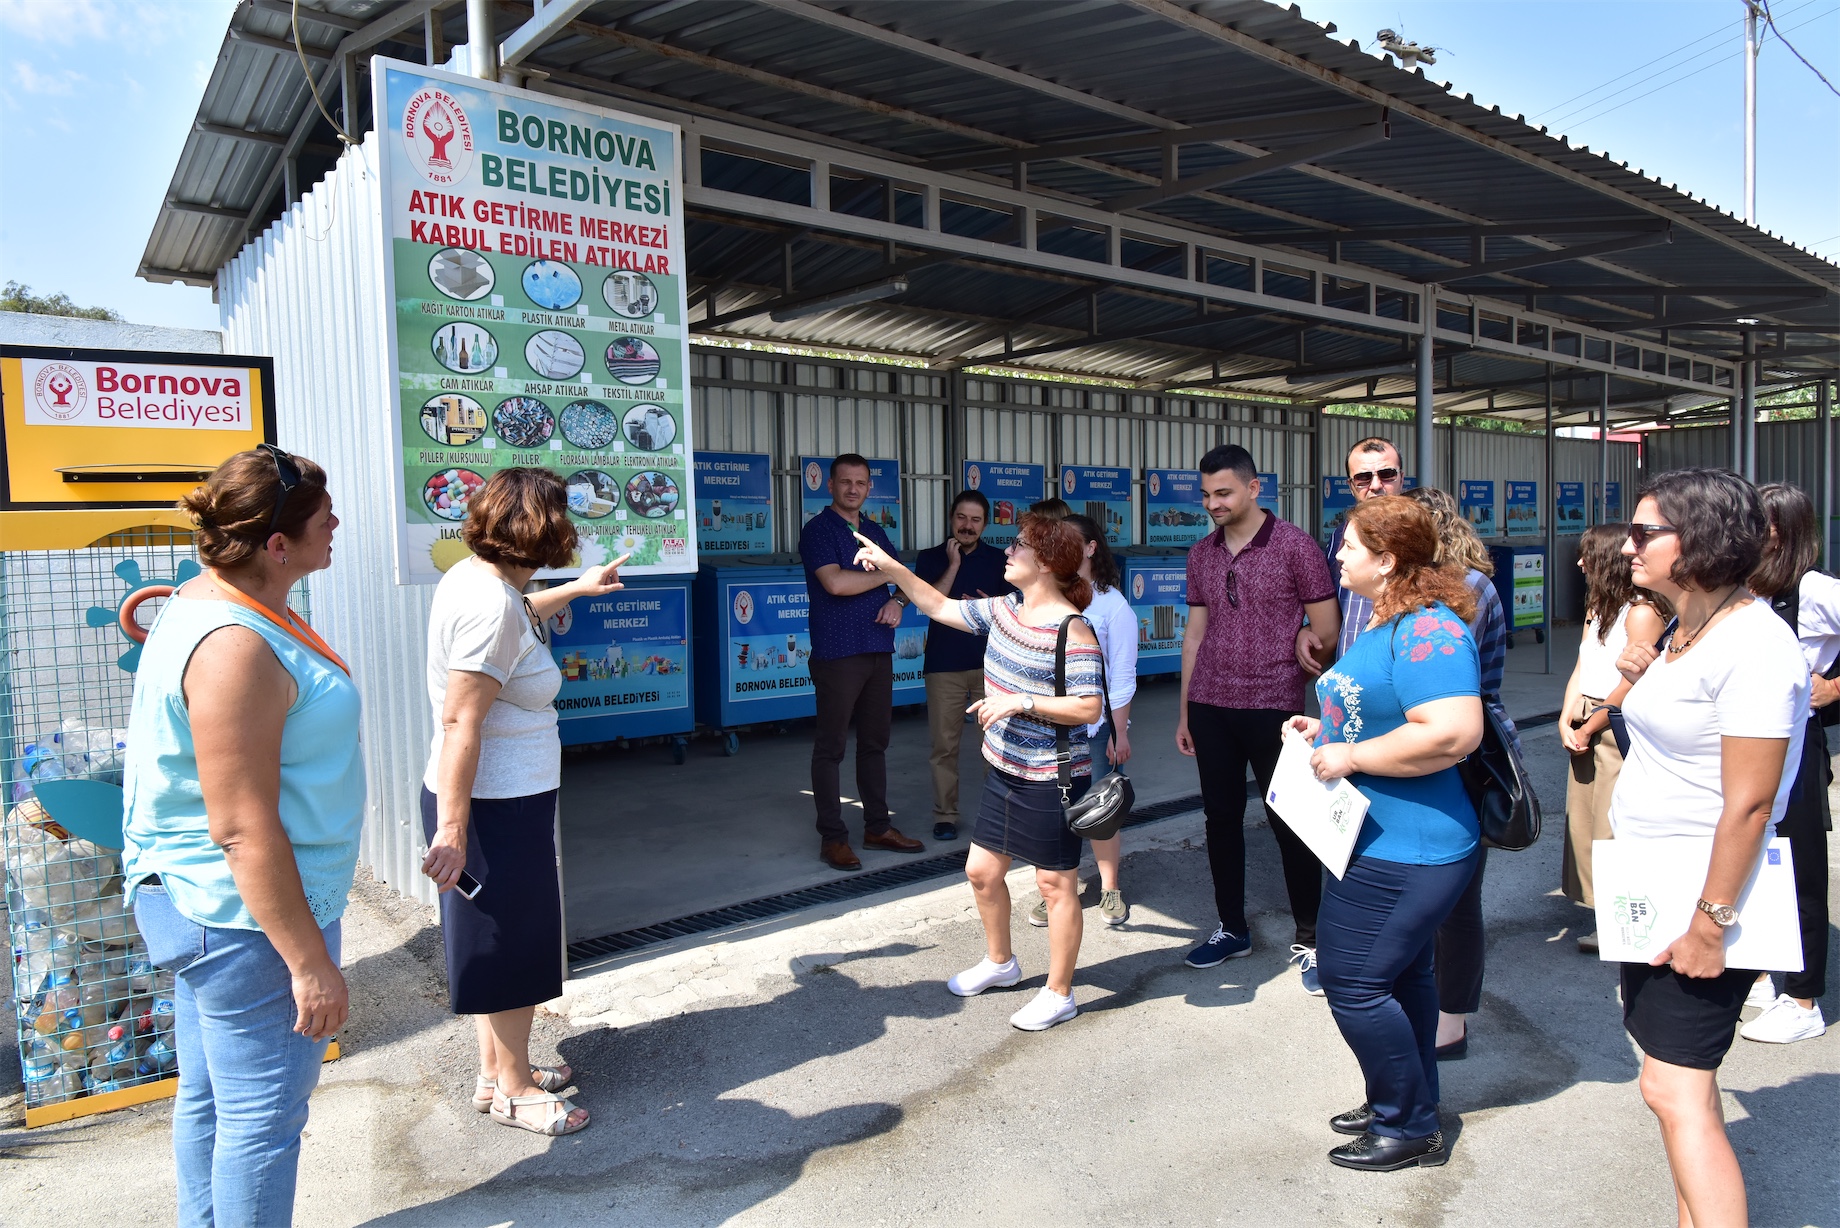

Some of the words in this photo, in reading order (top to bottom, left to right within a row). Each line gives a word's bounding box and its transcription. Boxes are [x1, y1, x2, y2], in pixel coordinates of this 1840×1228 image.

[406, 92, 431, 138] BORNOVA
[435, 91, 474, 152] BELEDİYESİ
[497, 109, 656, 172] BORNOVA
[428, 172, 452, 183] 1881
[481, 153, 671, 217] BELEDİYESİ
[408, 190, 466, 220] ATIK
[473, 201, 572, 235] GETİRME
[580, 216, 669, 249] MERKEZİ
[410, 220, 492, 253] KABUL
[499, 231, 578, 264] EDİLEN
[585, 245, 670, 276] ATIKLAR
[421, 300, 444, 315] KAĞIT
[446, 304, 475, 318] KARTON
[477, 308, 505, 320] ATIKLAR
[522, 311, 553, 326] PLASTİK
[555, 316, 586, 329] ATIKLAR
[608, 320, 629, 333] METAL
[630, 323, 655, 335] ATIKLAR
[96, 366, 241, 397] Bornova
[440, 377, 459, 390] CAM
[461, 379, 494, 392] ATIKLAR
[524, 382, 552, 397] AHŞAP
[555, 384, 588, 397] ATIKLAR
[602, 386, 632, 400] TEKSTİL
[634, 389, 665, 401] ATIKLAR
[97, 396, 241, 427] Belediyesi
[420, 448, 445, 463] PİLLER
[512, 450, 540, 465] PİLLER
[560, 454, 589, 465] FLORASAN
[591, 455, 620, 466] LAMBALAR
[656, 457, 678, 467] ATIKLAR
[693, 461, 712, 471] ATIK
[714, 460, 750, 472] GETİRME
[989, 466, 1004, 475] ATIK
[1004, 466, 1030, 476] GETİRME
[1083, 470, 1096, 478] ATIK
[1096, 469, 1119, 478] GETİRME
[703, 475, 741, 486] MERKEZİ
[996, 478, 1022, 487] MERKEZİ
[440, 525, 463, 542] İLAÇ
[704, 540, 750, 551] BELEDİYESİ
[1151, 573, 1165, 582] ATIK
[1157, 583, 1181, 592] MERKEZİ
[589, 602, 614, 614] ATIK
[616, 599, 661, 613] GETİRME
[766, 594, 787, 605] ATIK
[603, 615, 649, 630] MERKEZİ
[1137, 642, 1158, 652] ORNOVA
[1157, 640, 1183, 650] BELEDİYES
[735, 680, 777, 693] BORNOVA
[604, 690, 660, 706] BELEDİYESİ
[1630, 902, 1639, 923] BAN
[1638, 902, 1648, 916] UR
